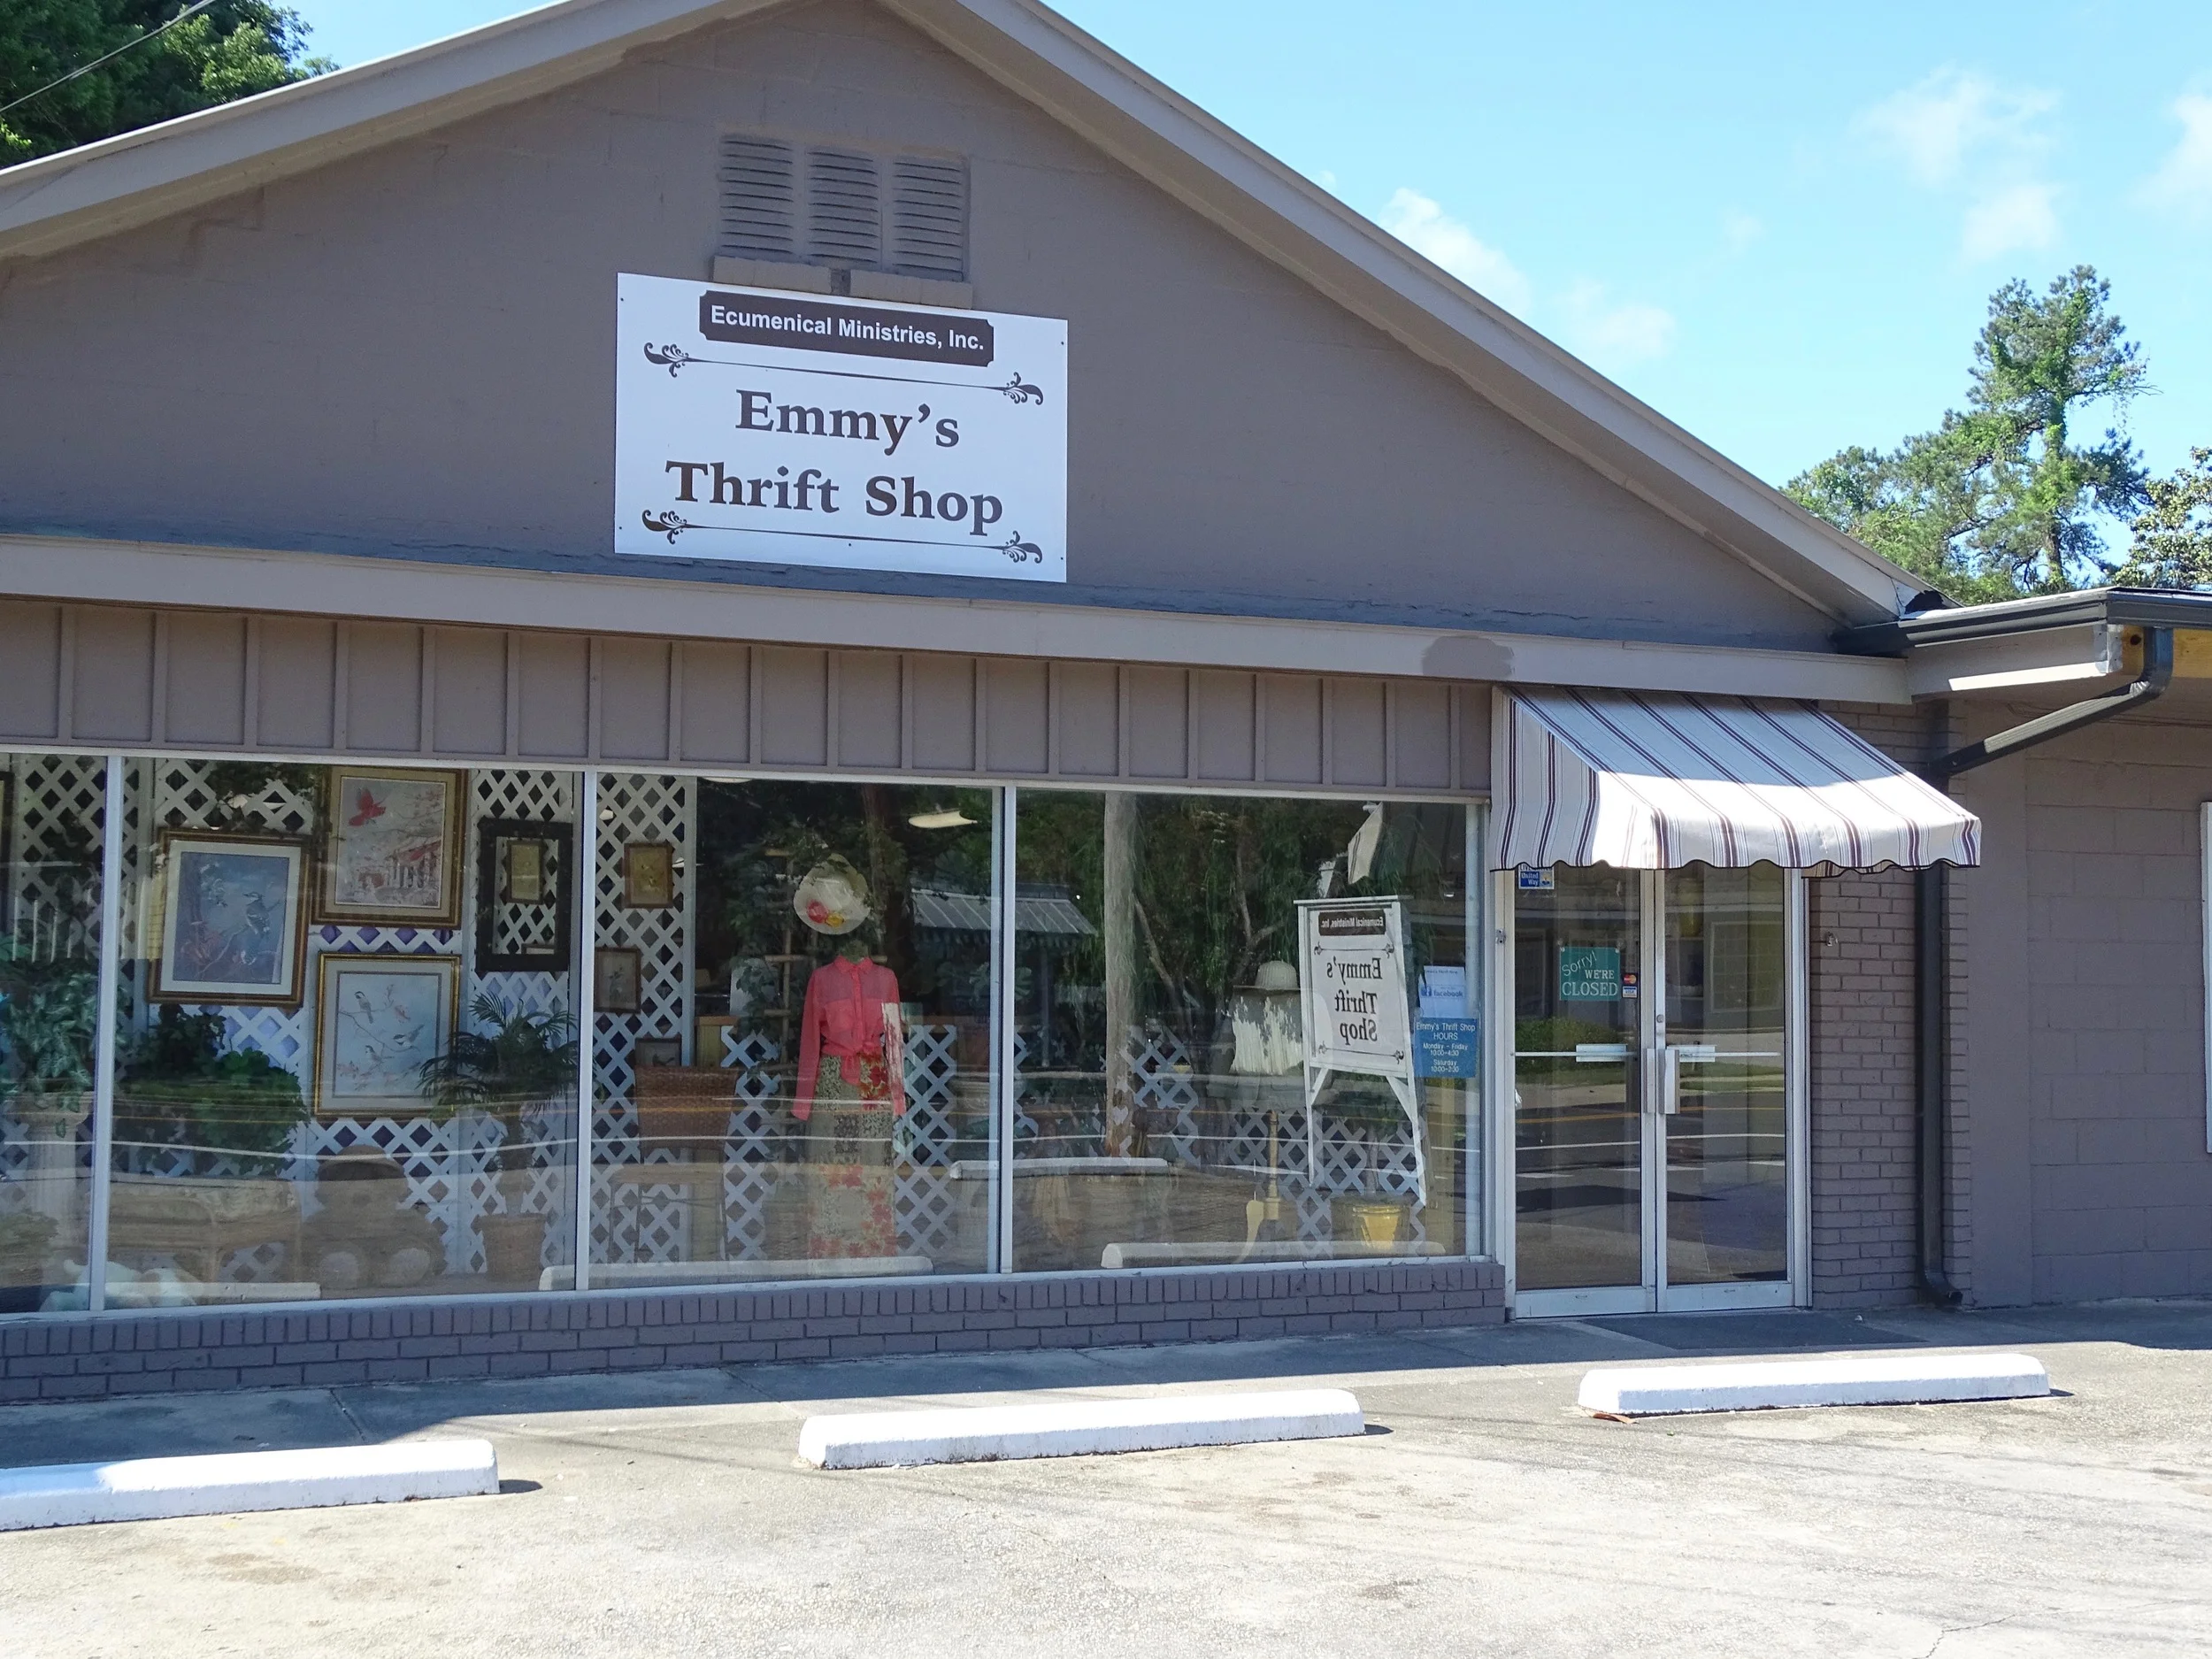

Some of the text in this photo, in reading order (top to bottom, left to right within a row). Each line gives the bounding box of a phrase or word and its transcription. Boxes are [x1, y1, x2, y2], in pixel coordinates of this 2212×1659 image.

[710, 304, 984, 350] Ecumenical Ministries, Inc.
[735, 388, 960, 456] Emmy's
[664, 459, 1003, 537] Thrift Shop
[1562, 949, 1597, 977] Sorry!
[1585, 969, 1615, 979] WE'RE
[1562, 981, 1618, 996] CLOSED
[1416, 1022, 1476, 1033] Emmy's Thrift Shop
[1433, 1032, 1458, 1041] HOURS
